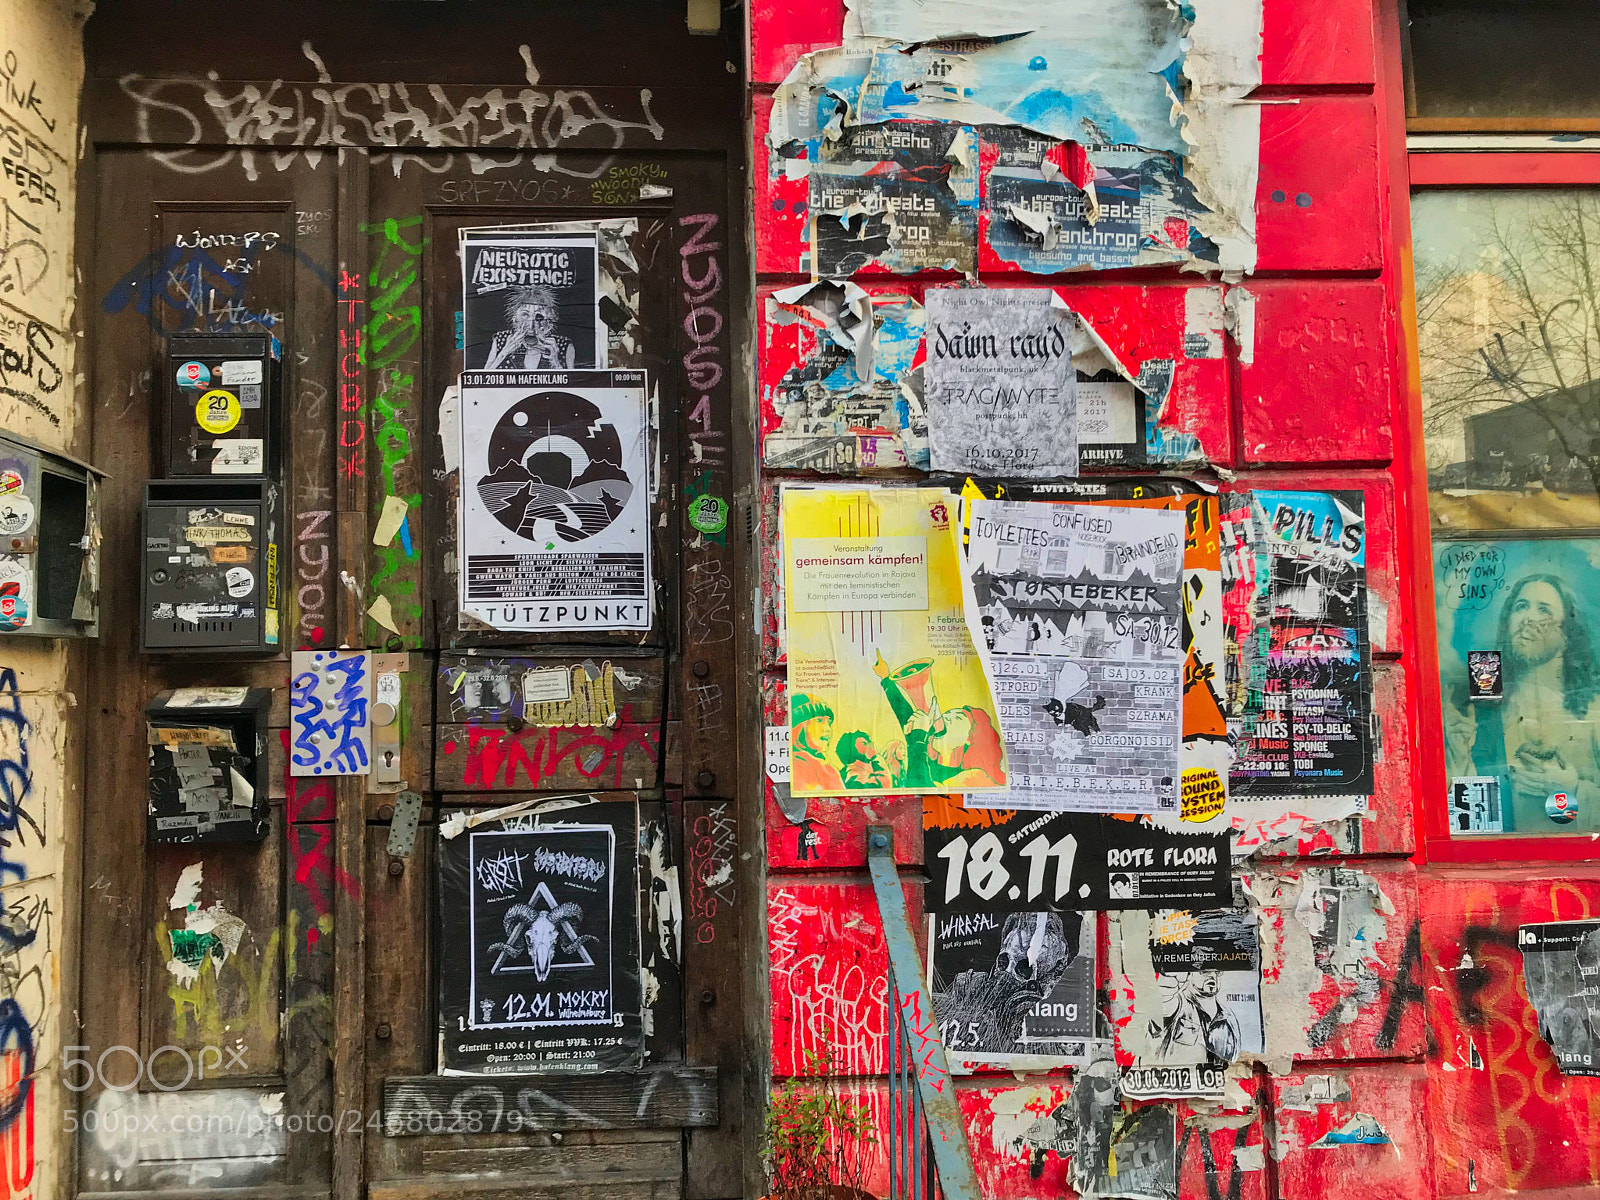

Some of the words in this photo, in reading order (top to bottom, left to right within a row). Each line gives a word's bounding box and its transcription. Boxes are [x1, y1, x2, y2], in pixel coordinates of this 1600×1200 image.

[810, 190, 845, 208] the
[482, 250, 570, 269] NEUROTIC
[1077, 251, 1095, 262] and
[478, 267, 574, 286] EXISTENCE
[463, 374, 504, 386] 13.01.2018
[506, 374, 517, 385] IM
[517, 374, 569, 386] HAFENKLANG
[208, 395, 229, 411] 20
[965, 445, 1039, 462] 16.10.2017
[1080, 449, 1123, 460] ARRIVE
[970, 459, 998, 471] Rote
[1002, 459, 1035, 471] Flora
[700, 498, 720, 513] 20
[833, 544, 884, 553] Veranstaltung
[795, 555, 865, 569] gemeinsam
[868, 553, 924, 567] kämpfen!
[803, 572, 817, 580] Die
[818, 570, 880, 579] Frauenrevolution
[890, 570, 916, 579] Rojava
[1454, 567, 1472, 580] MY
[1474, 564, 1497, 578] OWN
[819, 582, 832, 590] mit
[833, 582, 848, 590] den
[849, 581, 901, 589] feministischen
[807, 592, 841, 601] Kämpfen
[842, 592, 850, 600] in
[851, 591, 878, 601] Europa
[879, 591, 917, 600] verbinden
[475, 603, 645, 623] TÜTZPUNKT
[927, 616, 935, 624] 1.
[1135, 685, 1174, 697] KRANK
[1291, 689, 1340, 700] PSYDONNA
[1127, 711, 1174, 722] SZRAMA
[1292, 706, 1325, 717] VIKASH
[1292, 723, 1352, 734] PSY-TO-DELIC
[1306, 734, 1343, 742] Department
[1258, 739, 1289, 750] Music
[1293, 741, 1329, 752] SPONGE
[1057, 765, 1076, 773] LIVE
[1293, 759, 1314, 770] TOBI
[1181, 770, 1218, 783] RIGINAL
[1294, 769, 1323, 778] Psyonara
[1324, 769, 1344, 777] Music
[1180, 790, 1226, 808] YSTEM
[1106, 848, 1155, 868] ROTE
[1163, 846, 1218, 867] FLORA
[937, 832, 1091, 904] 18.11.
[1172, 917, 1199, 931] TASK
[556, 989, 609, 1009] MOKRY
[458, 1043, 492, 1054] Eintritt:
[494, 1041, 517, 1051] 18.00
[534, 1039, 565, 1049] Eintritt
[593, 1037, 616, 1046] 17.25
[512, 1053, 537, 1062] 20:00
[573, 1050, 596, 1059] 21:00
